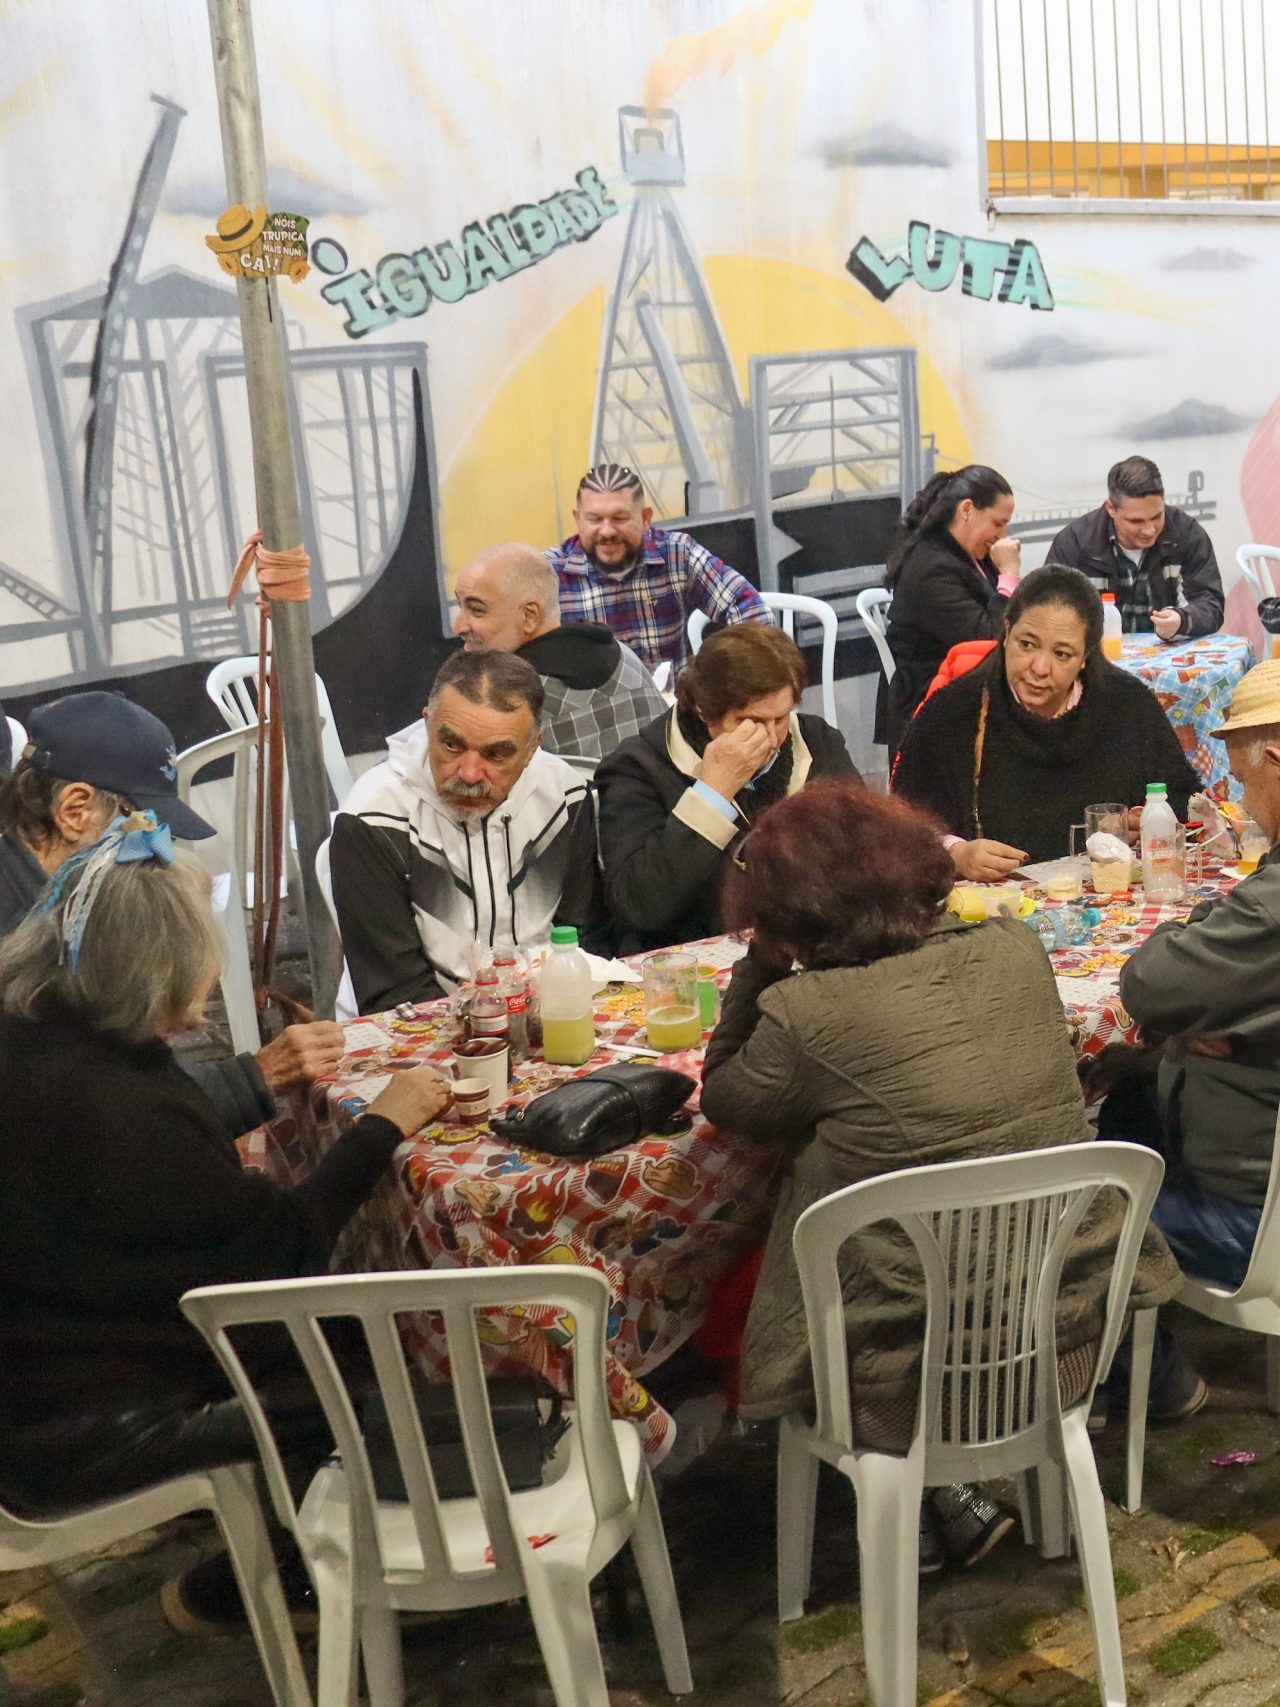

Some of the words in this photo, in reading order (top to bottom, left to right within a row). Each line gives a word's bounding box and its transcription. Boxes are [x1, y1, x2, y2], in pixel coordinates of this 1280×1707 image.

[274, 216, 296, 229] NÓIS
[262, 231, 304, 242] TRUPICA
[263, 244, 282, 254] MAIS
[283, 247, 302, 257] NUM
[846, 220, 1054, 311] LUTA
